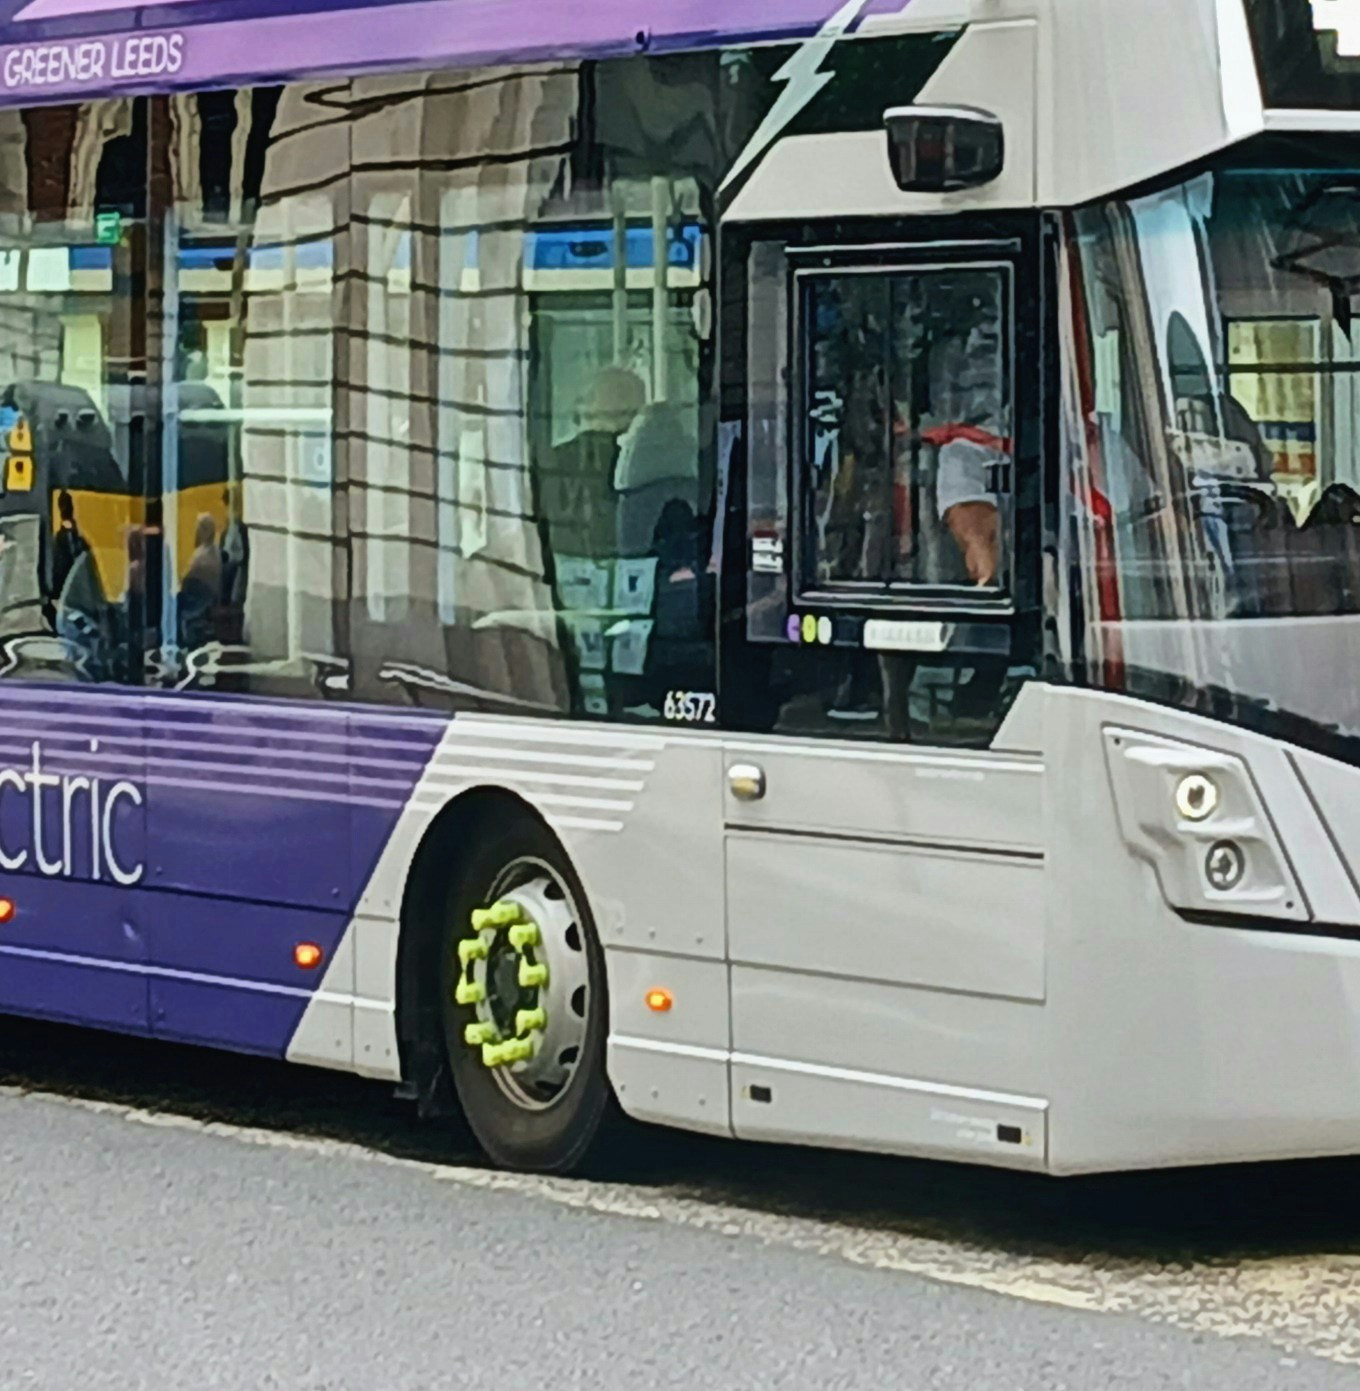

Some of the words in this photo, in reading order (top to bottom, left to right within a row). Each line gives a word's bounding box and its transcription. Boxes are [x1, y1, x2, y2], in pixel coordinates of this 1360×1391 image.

[3, 41, 106, 88] GREENER
[110, 33, 184, 79] LEEDS
[663, 690, 717, 723] 63572
